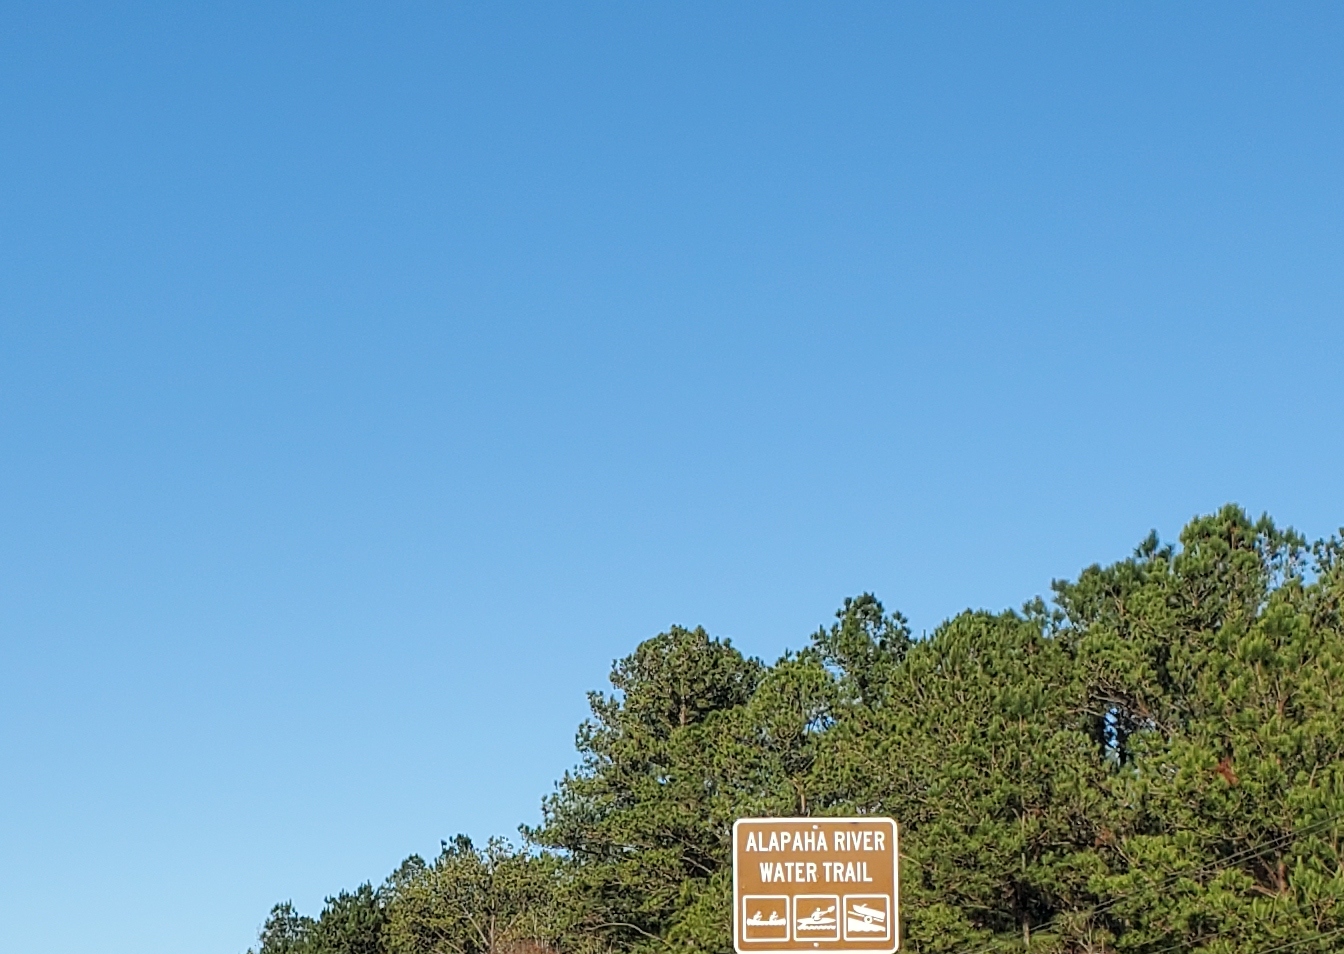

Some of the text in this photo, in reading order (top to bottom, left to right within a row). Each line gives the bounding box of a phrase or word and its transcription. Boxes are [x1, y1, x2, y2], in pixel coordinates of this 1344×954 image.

[745, 830, 885, 852] ALAPAHA RIVER
[759, 861, 873, 883] WATER TRAIL
